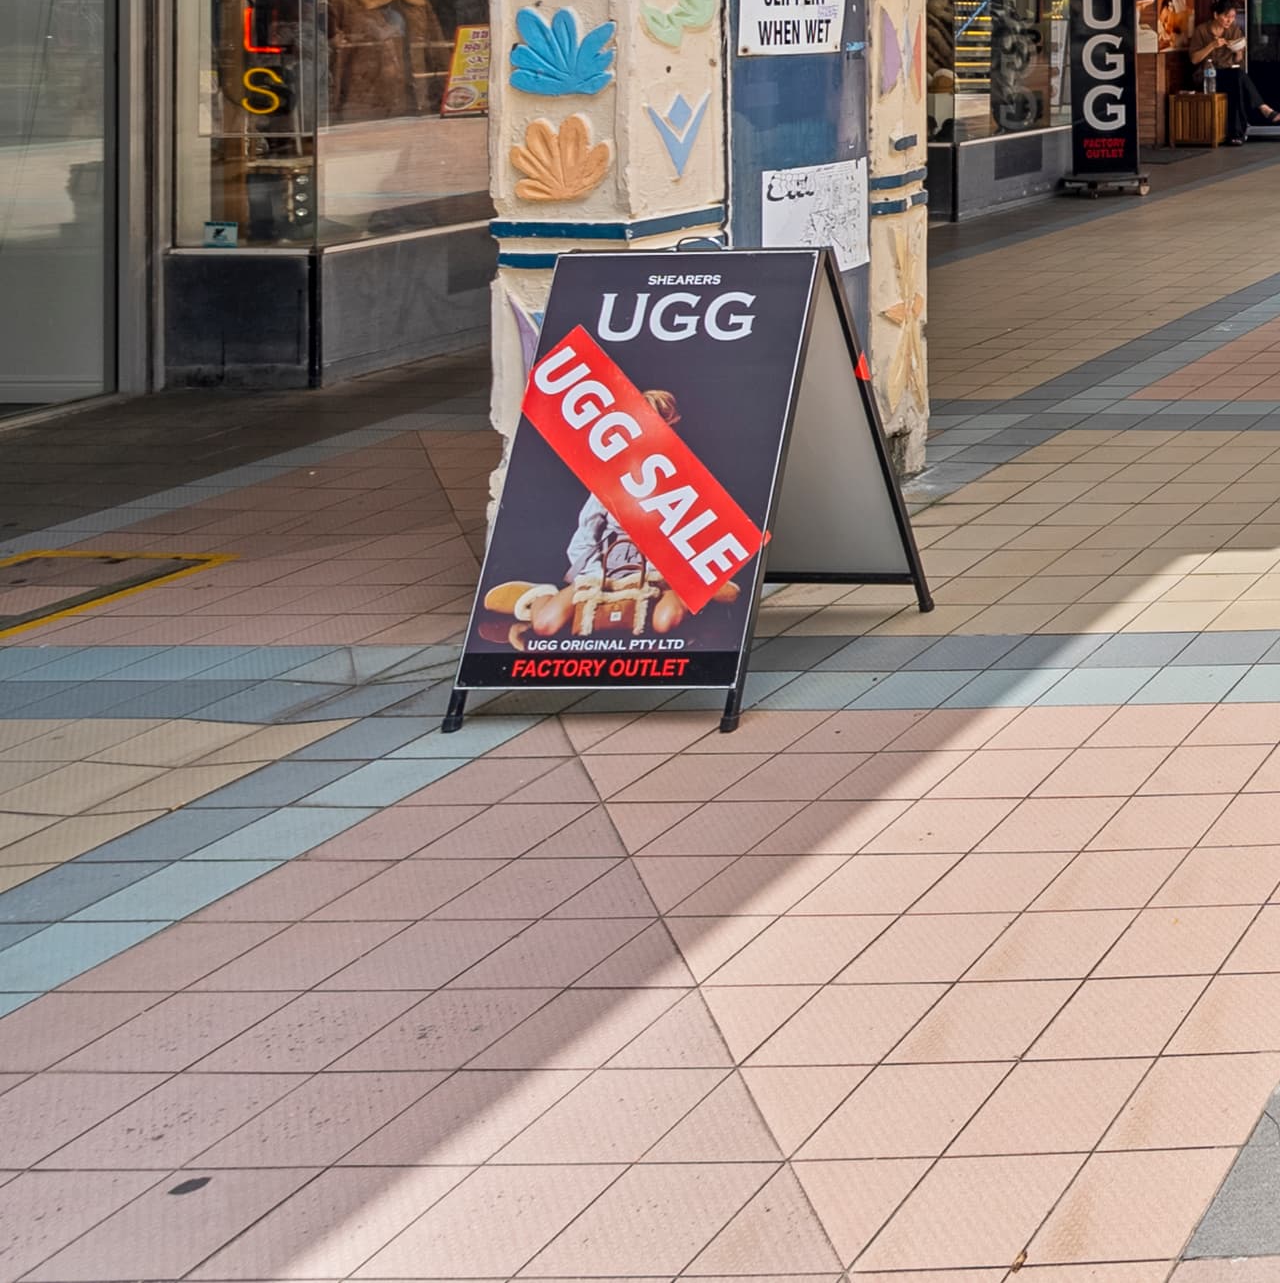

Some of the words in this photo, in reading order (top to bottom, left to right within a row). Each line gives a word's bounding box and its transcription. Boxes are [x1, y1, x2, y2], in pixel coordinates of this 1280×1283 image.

[758, 20, 801, 47] WHEN
[804, 18, 832, 44] WET
[1083, 138, 1126, 150] FACTORY
[1085, 147, 1125, 160] OUTLET
[647, 274, 722, 286] SHEARERS
[597, 290, 756, 342] UGG
[532, 345, 642, 463] UGG
[619, 453, 750, 586] SALE
[527, 639, 559, 651] UGG
[561, 639, 626, 651] ORIGINAL
[629, 639, 657, 651] PTY
[658, 639, 685, 650] LTD
[511, 658, 606, 678] FACTORY
[608, 657, 690, 678] OUTLET
